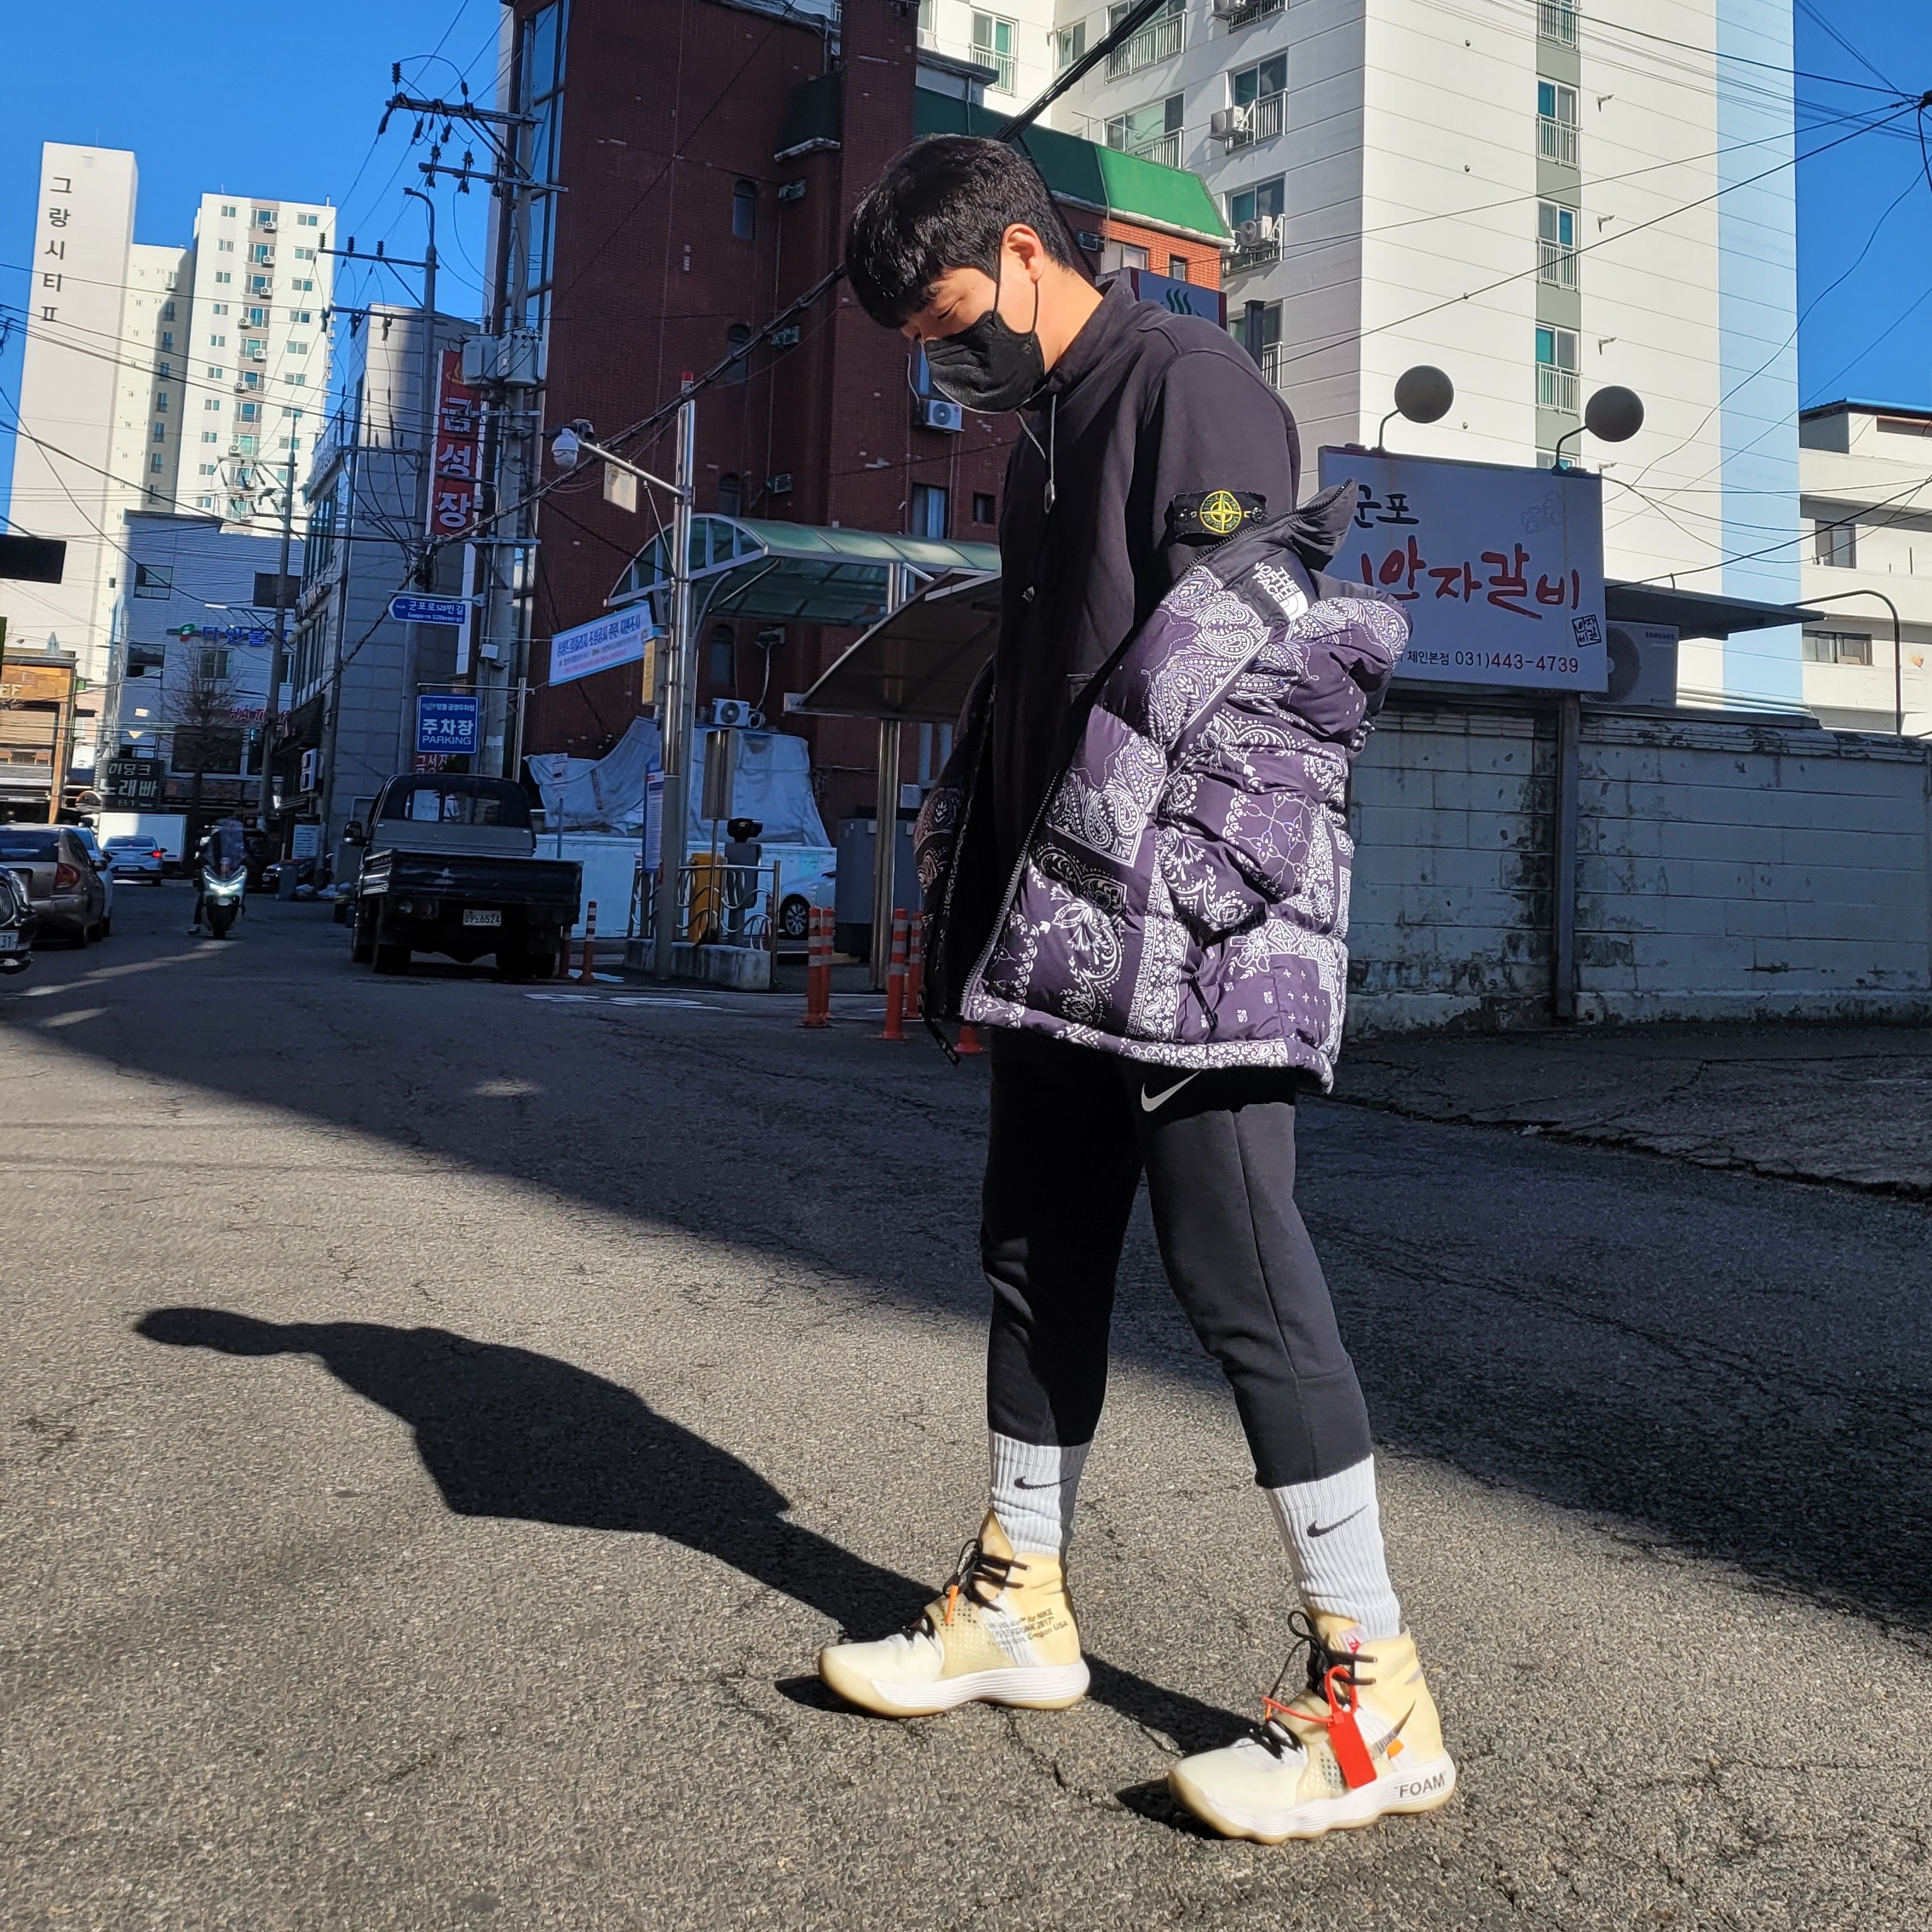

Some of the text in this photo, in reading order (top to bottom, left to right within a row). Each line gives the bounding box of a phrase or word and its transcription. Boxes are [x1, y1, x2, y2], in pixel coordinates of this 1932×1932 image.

[1251, 572, 1285, 602] FACE
[1278, 566, 1301, 592] THE
[1645, 631, 1675, 640] SAMSUNG
[1407, 650, 1578, 673] 체인본점 031)443-4739
[422, 718, 474, 736] 주차장
[423, 735, 472, 745] PARKING
[99, 778, 159, 798] 노래빠
[1053, 1620, 1068, 1631] USA
